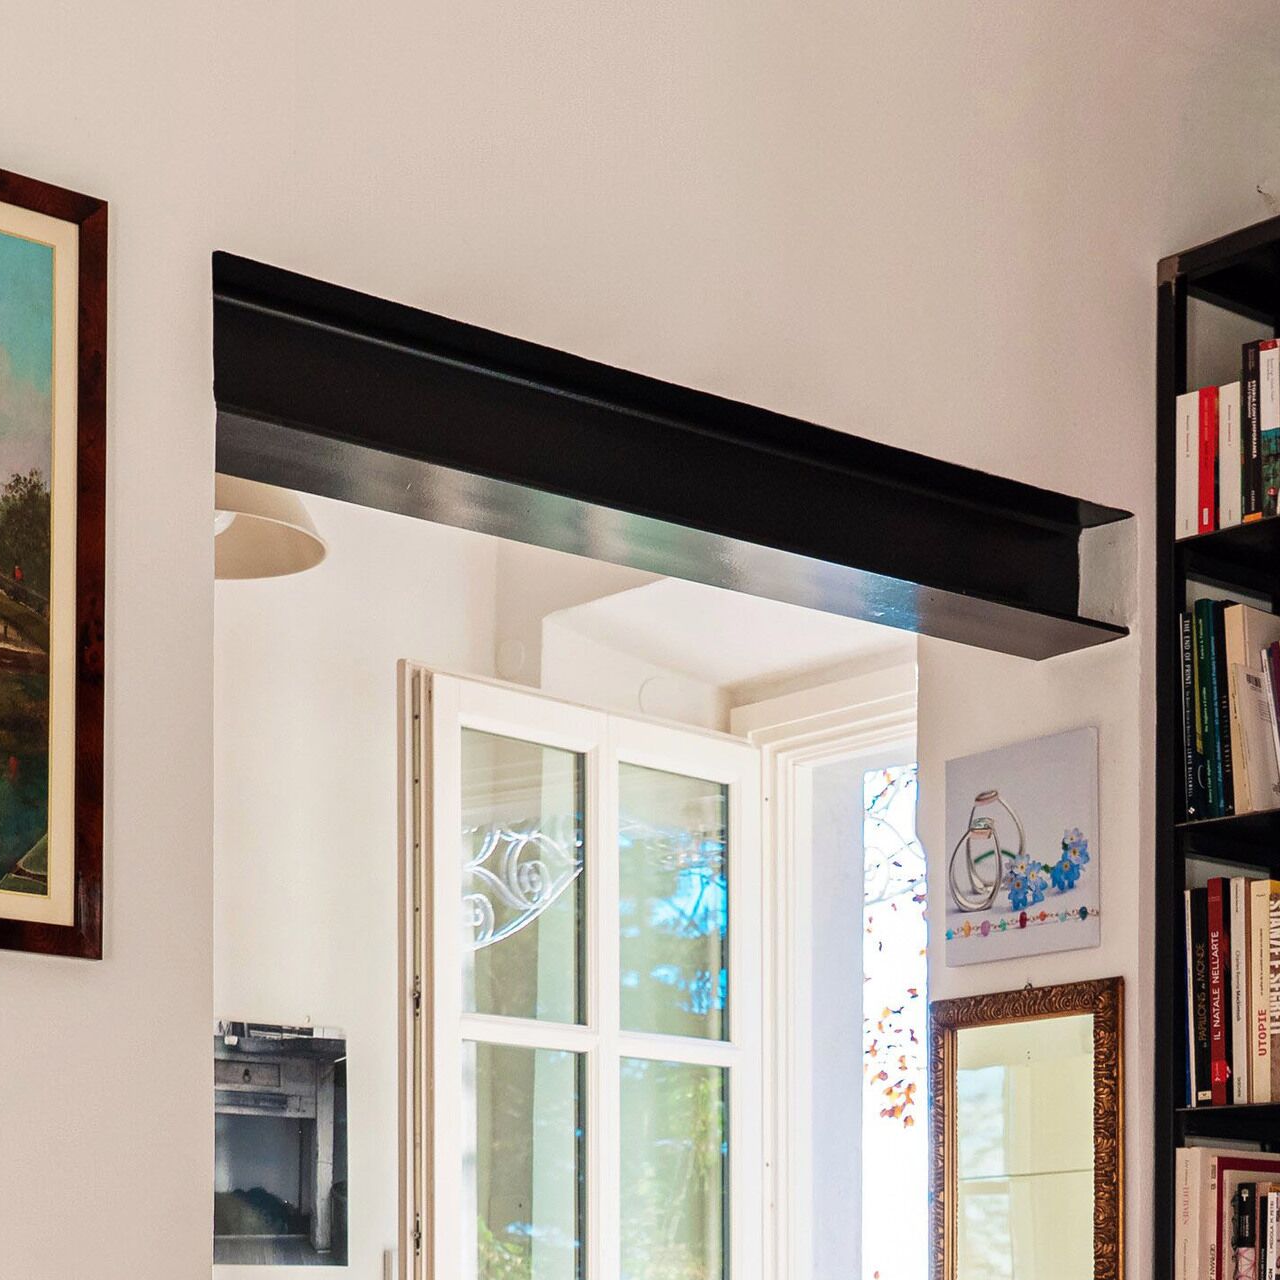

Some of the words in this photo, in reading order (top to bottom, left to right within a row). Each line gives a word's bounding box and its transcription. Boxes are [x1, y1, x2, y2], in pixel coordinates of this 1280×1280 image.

[1183, 619, 1191, 633] THE
[1184, 652, 1191, 662] OF
[1196, 943, 1205, 982] MONDE
[1210, 931, 1220, 984] NELL'ARTE
[1196, 992, 1207, 1041] PAPILLONS
[1212, 988, 1221, 1028] NATALE
[1213, 1031, 1221, 1041] IL
[1257, 1009, 1267, 1057] UTOPIE
